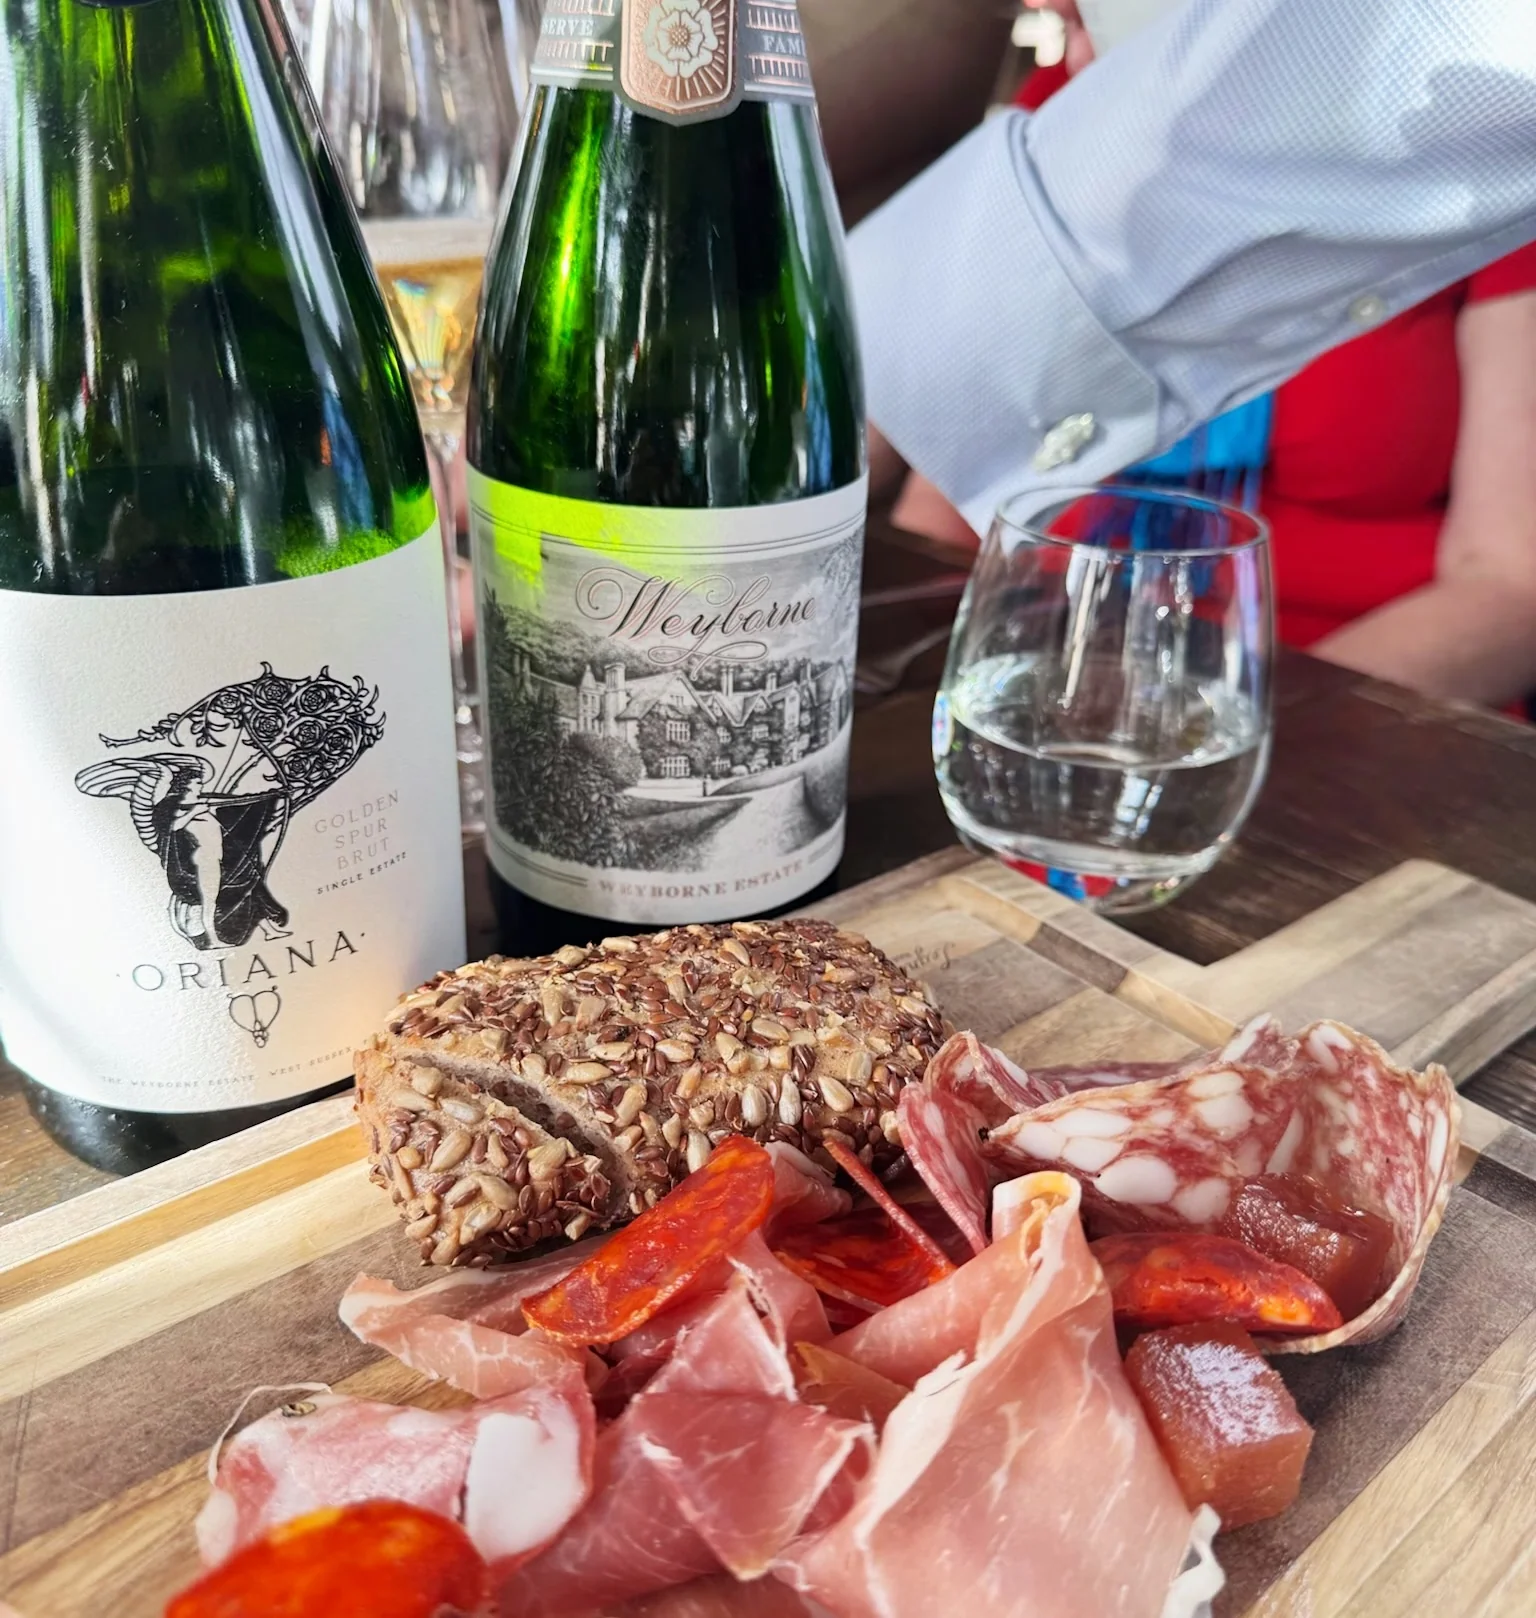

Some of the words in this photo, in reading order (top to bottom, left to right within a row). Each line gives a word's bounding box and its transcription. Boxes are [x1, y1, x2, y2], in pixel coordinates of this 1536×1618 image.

[314, 789, 399, 834] GOLDEN
[335, 818, 388, 849] SPUR
[337, 837, 389, 870] BRUT
[317, 873, 363, 895] SINGLE
[368, 851, 406, 876] ESTATE
[598, 879, 727, 899] WEYBORNE
[733, 859, 803, 891] ESTATE
[269, 1063, 301, 1076] WEST
